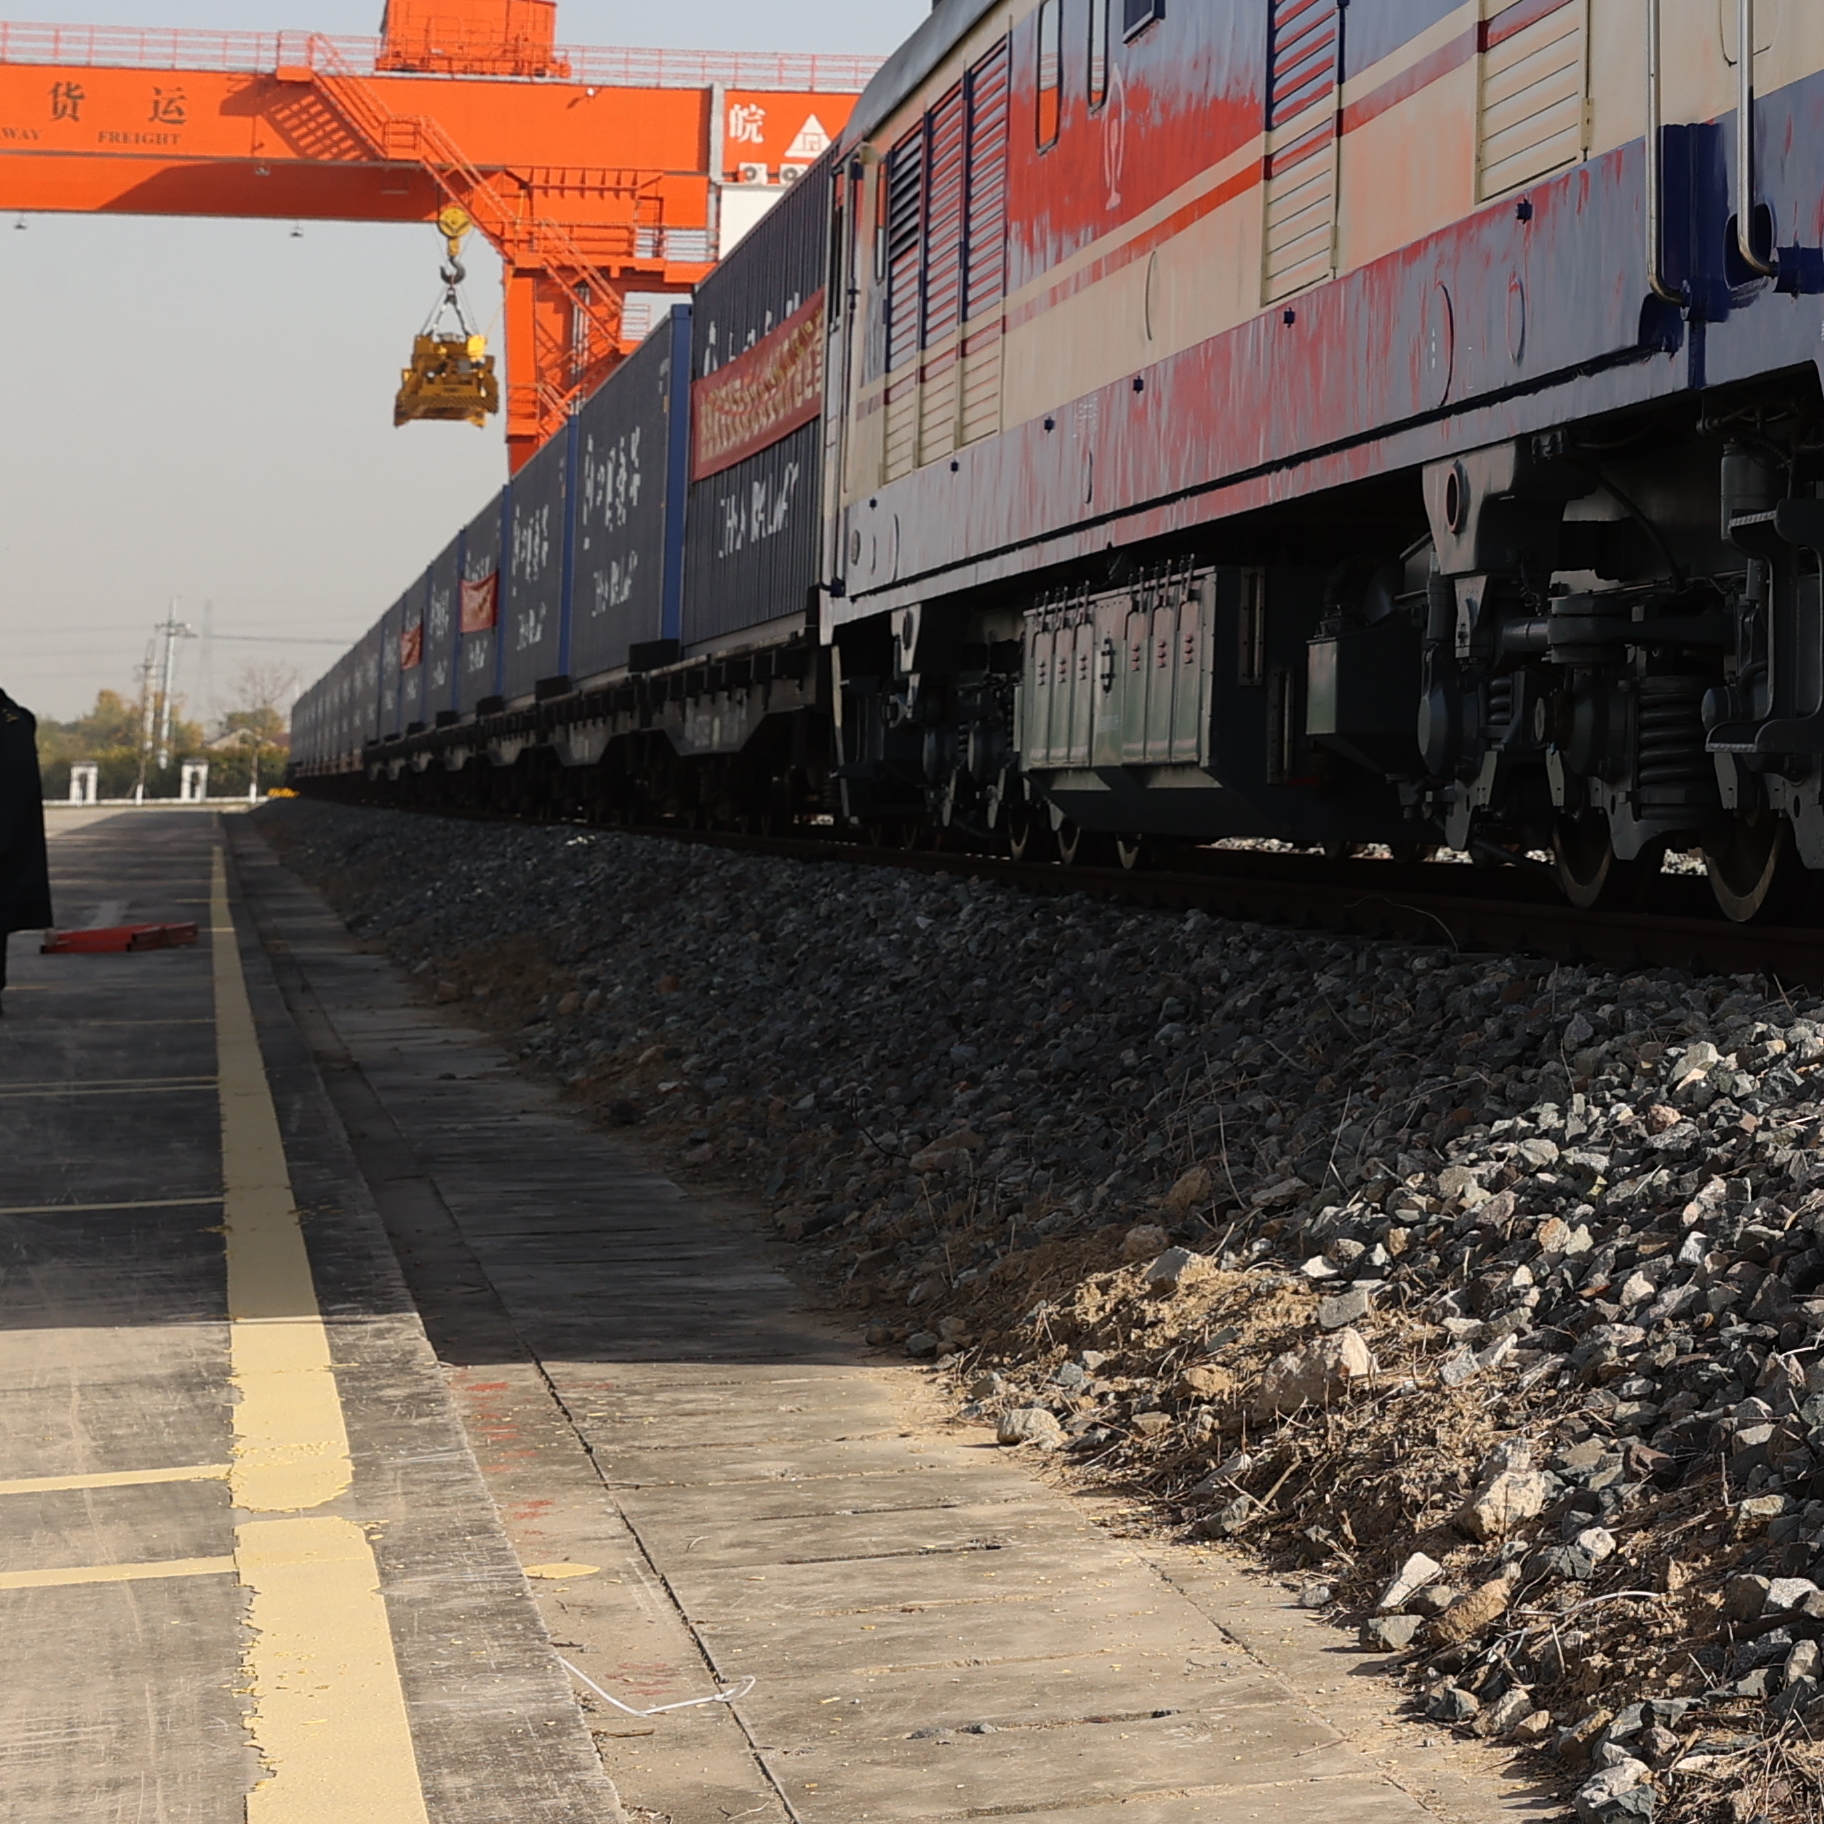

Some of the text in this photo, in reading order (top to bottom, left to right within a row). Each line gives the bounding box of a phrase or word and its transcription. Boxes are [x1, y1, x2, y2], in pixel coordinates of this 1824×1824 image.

[49, 80, 187, 125] 货运
[0, 127, 181, 145] WAY FREIGHT
